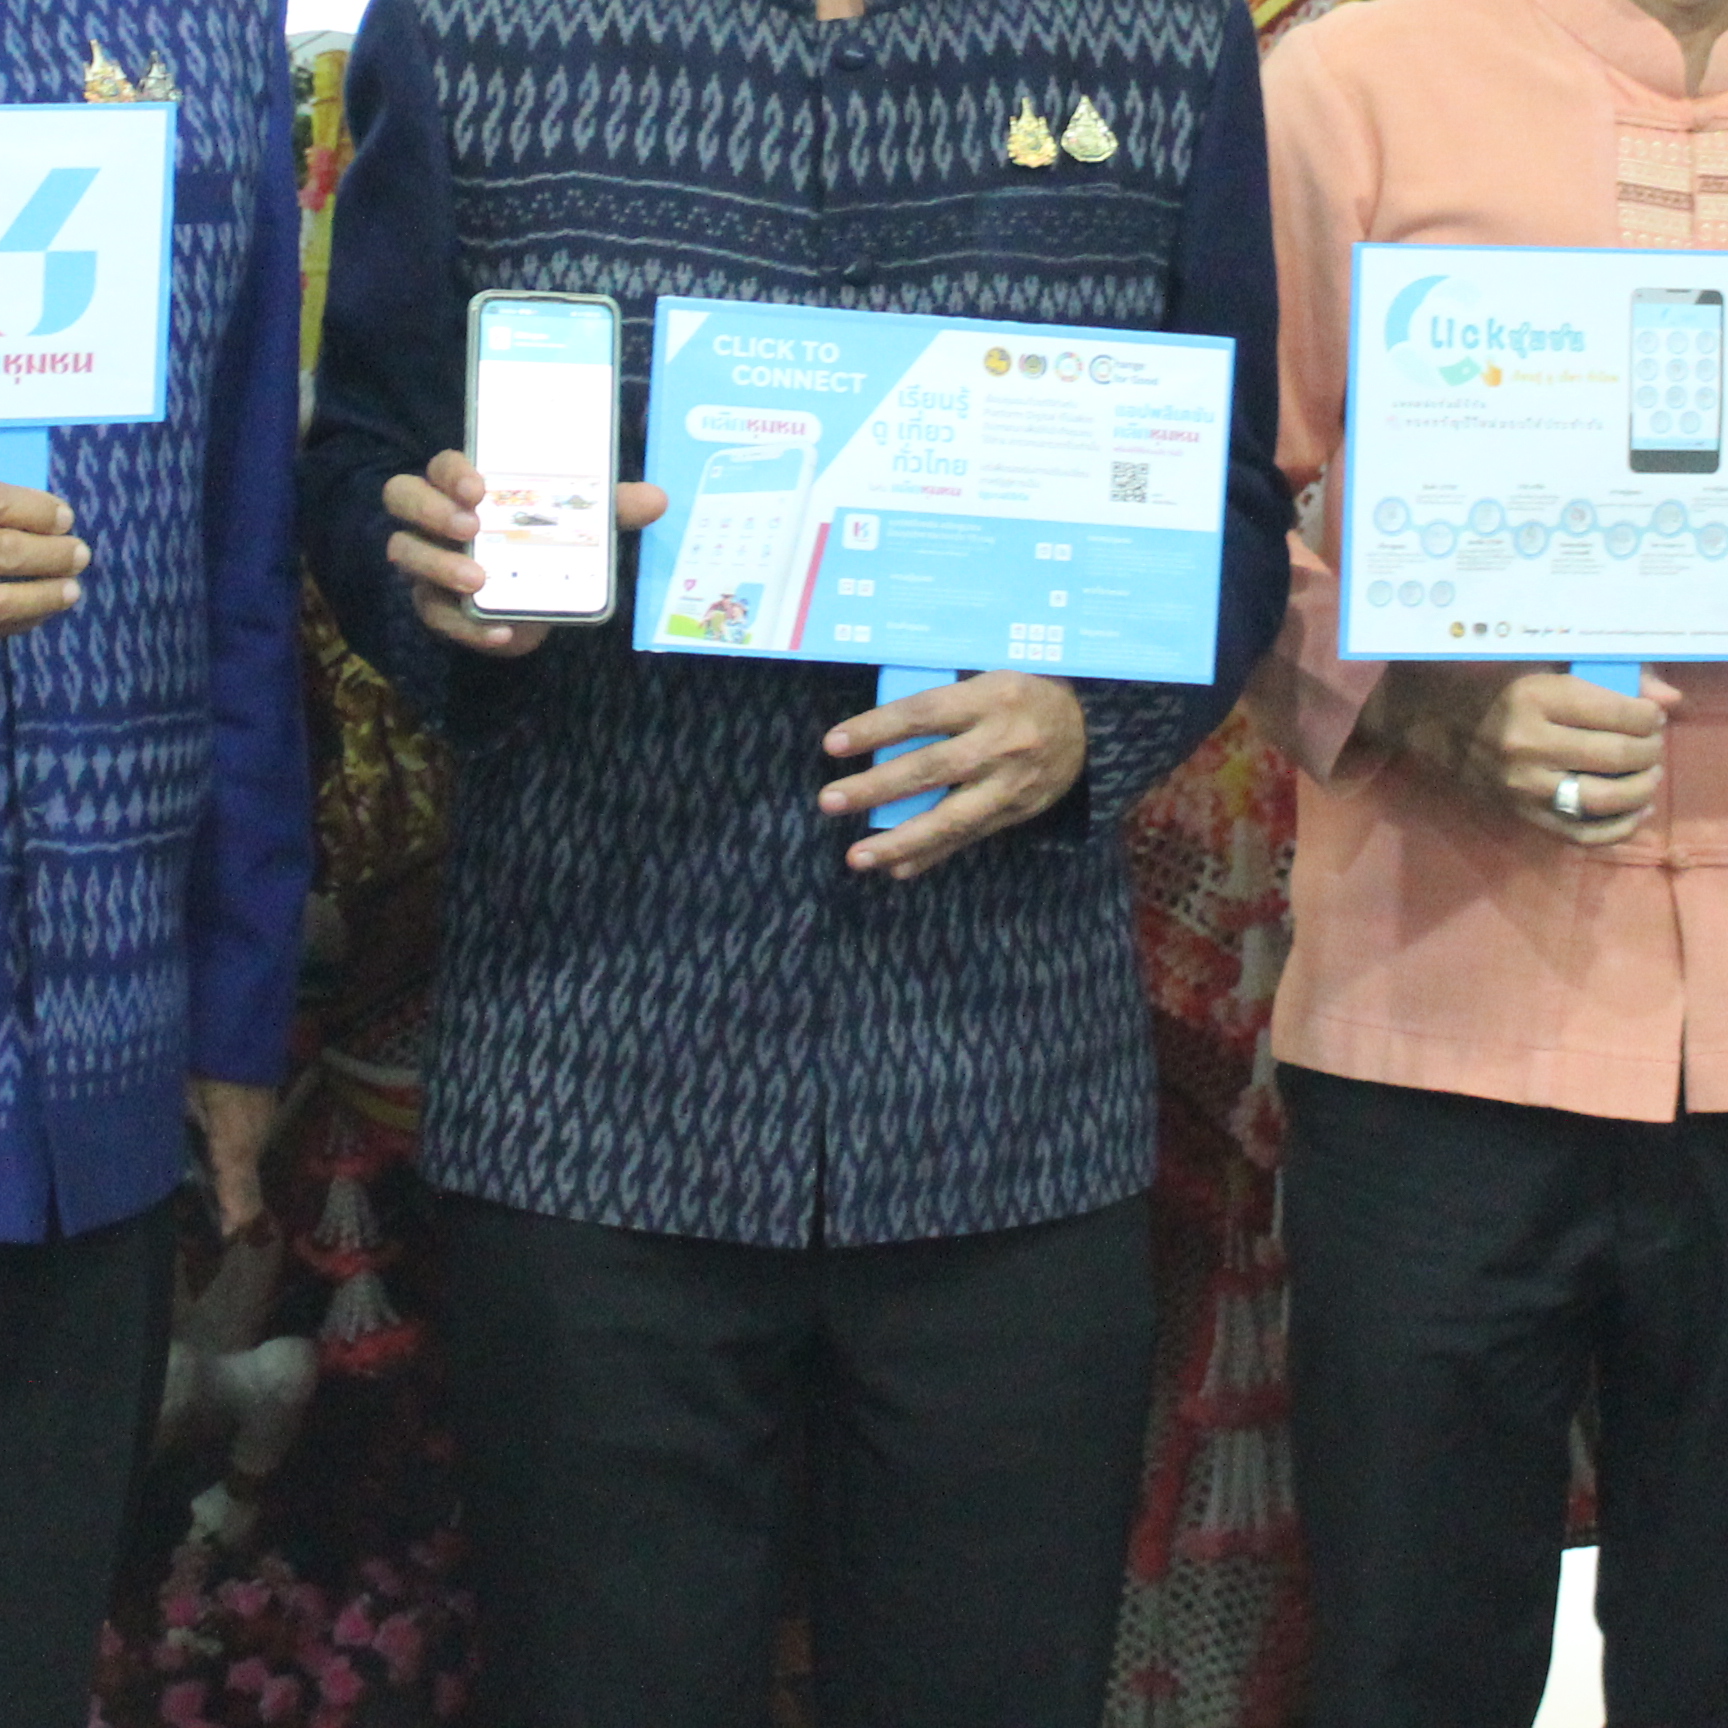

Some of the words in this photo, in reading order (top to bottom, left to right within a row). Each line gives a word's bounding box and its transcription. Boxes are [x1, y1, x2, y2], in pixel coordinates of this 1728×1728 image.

[713, 334, 795, 362] CLICK
[801, 341, 840, 363] TO
[732, 364, 868, 394] CONNECT
[897, 384, 970, 419] เรียนรู้
[702, 411, 807, 439] คลิกชุมชน
[872, 420, 888, 445] ดู
[897, 410, 955, 442] เที่ยว
[892, 442, 968, 476] ทั่วไทย
